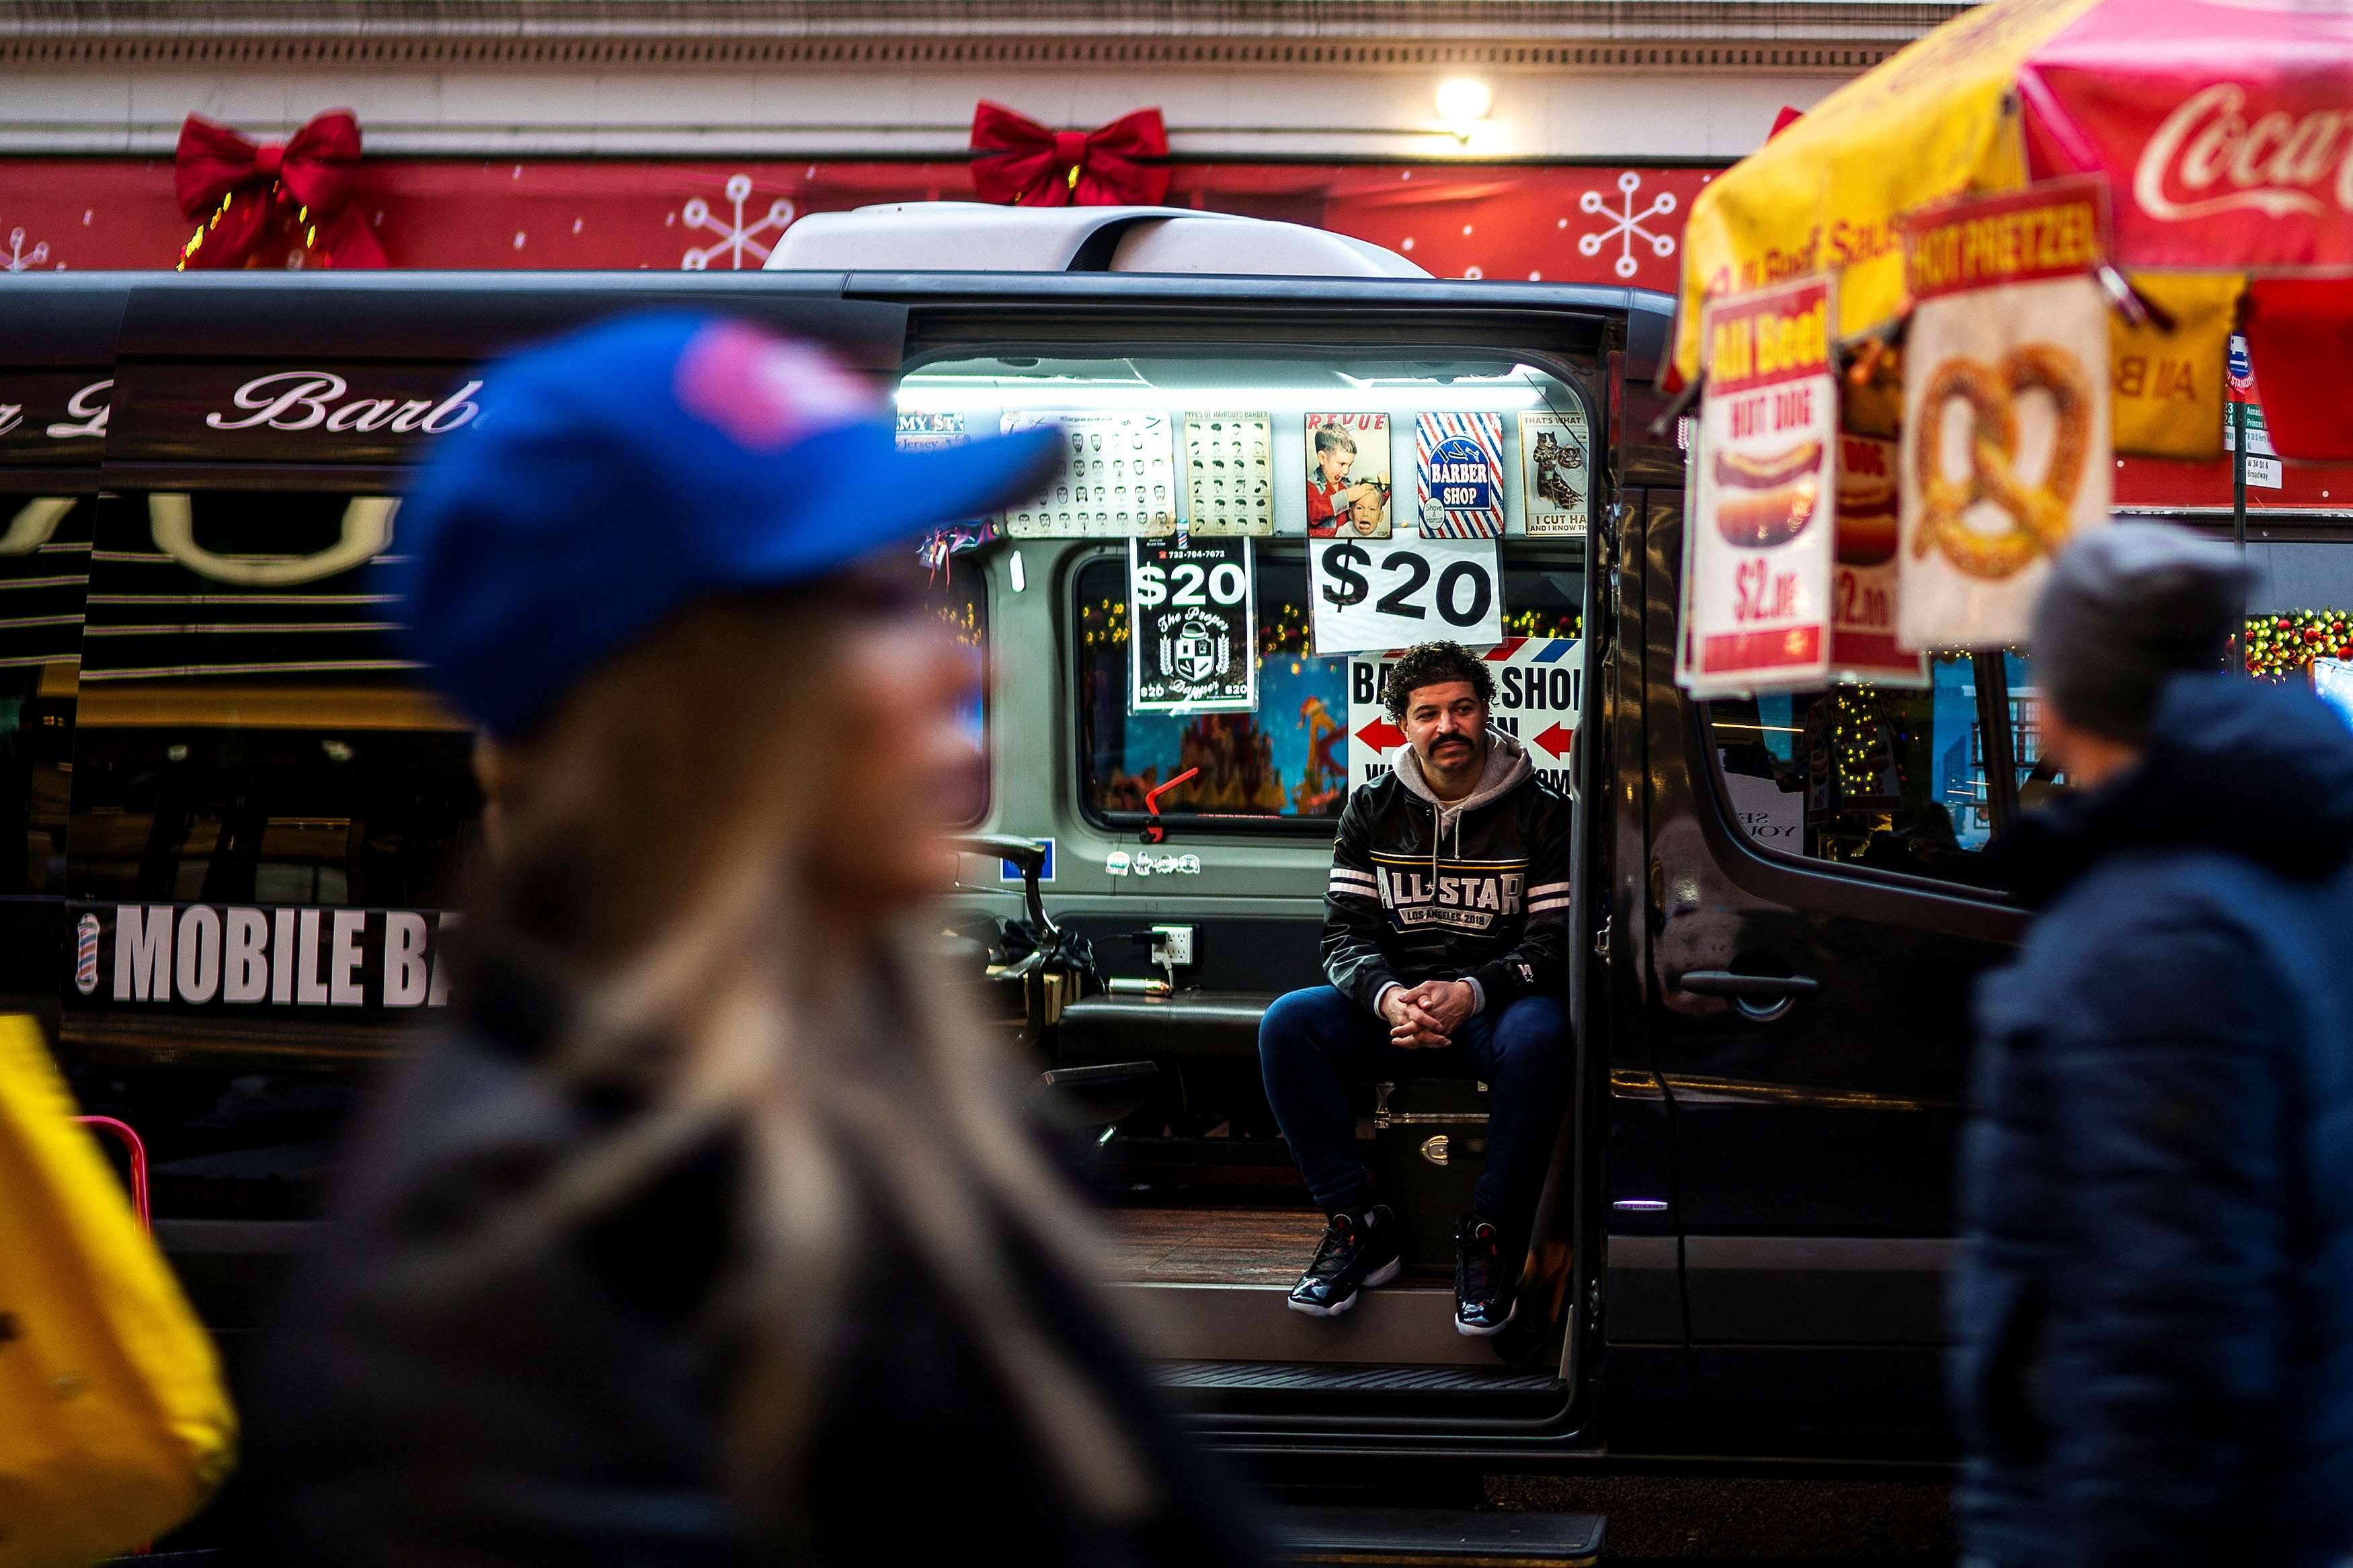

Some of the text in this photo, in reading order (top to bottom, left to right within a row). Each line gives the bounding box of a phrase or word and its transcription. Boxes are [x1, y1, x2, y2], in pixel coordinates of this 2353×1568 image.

[206, 371, 489, 433] Barb
[1307, 413, 1386, 431] REVUE
[1431, 463, 1488, 483] BARBER
[2247, 470, 2268, 481] Broadway
[1443, 487, 1477, 505] SHOP
[1544, 515, 1566, 524] CUT
[1136, 561, 1246, 610] $20
[1322, 537, 1492, 627] $20
[1157, 612, 1182, 632] The
[1376, 866, 1525, 915] ALL STAR
[1407, 910, 1485, 925] LOS ANGELES 2018
[114, 904, 365, 1006] MOBILE
